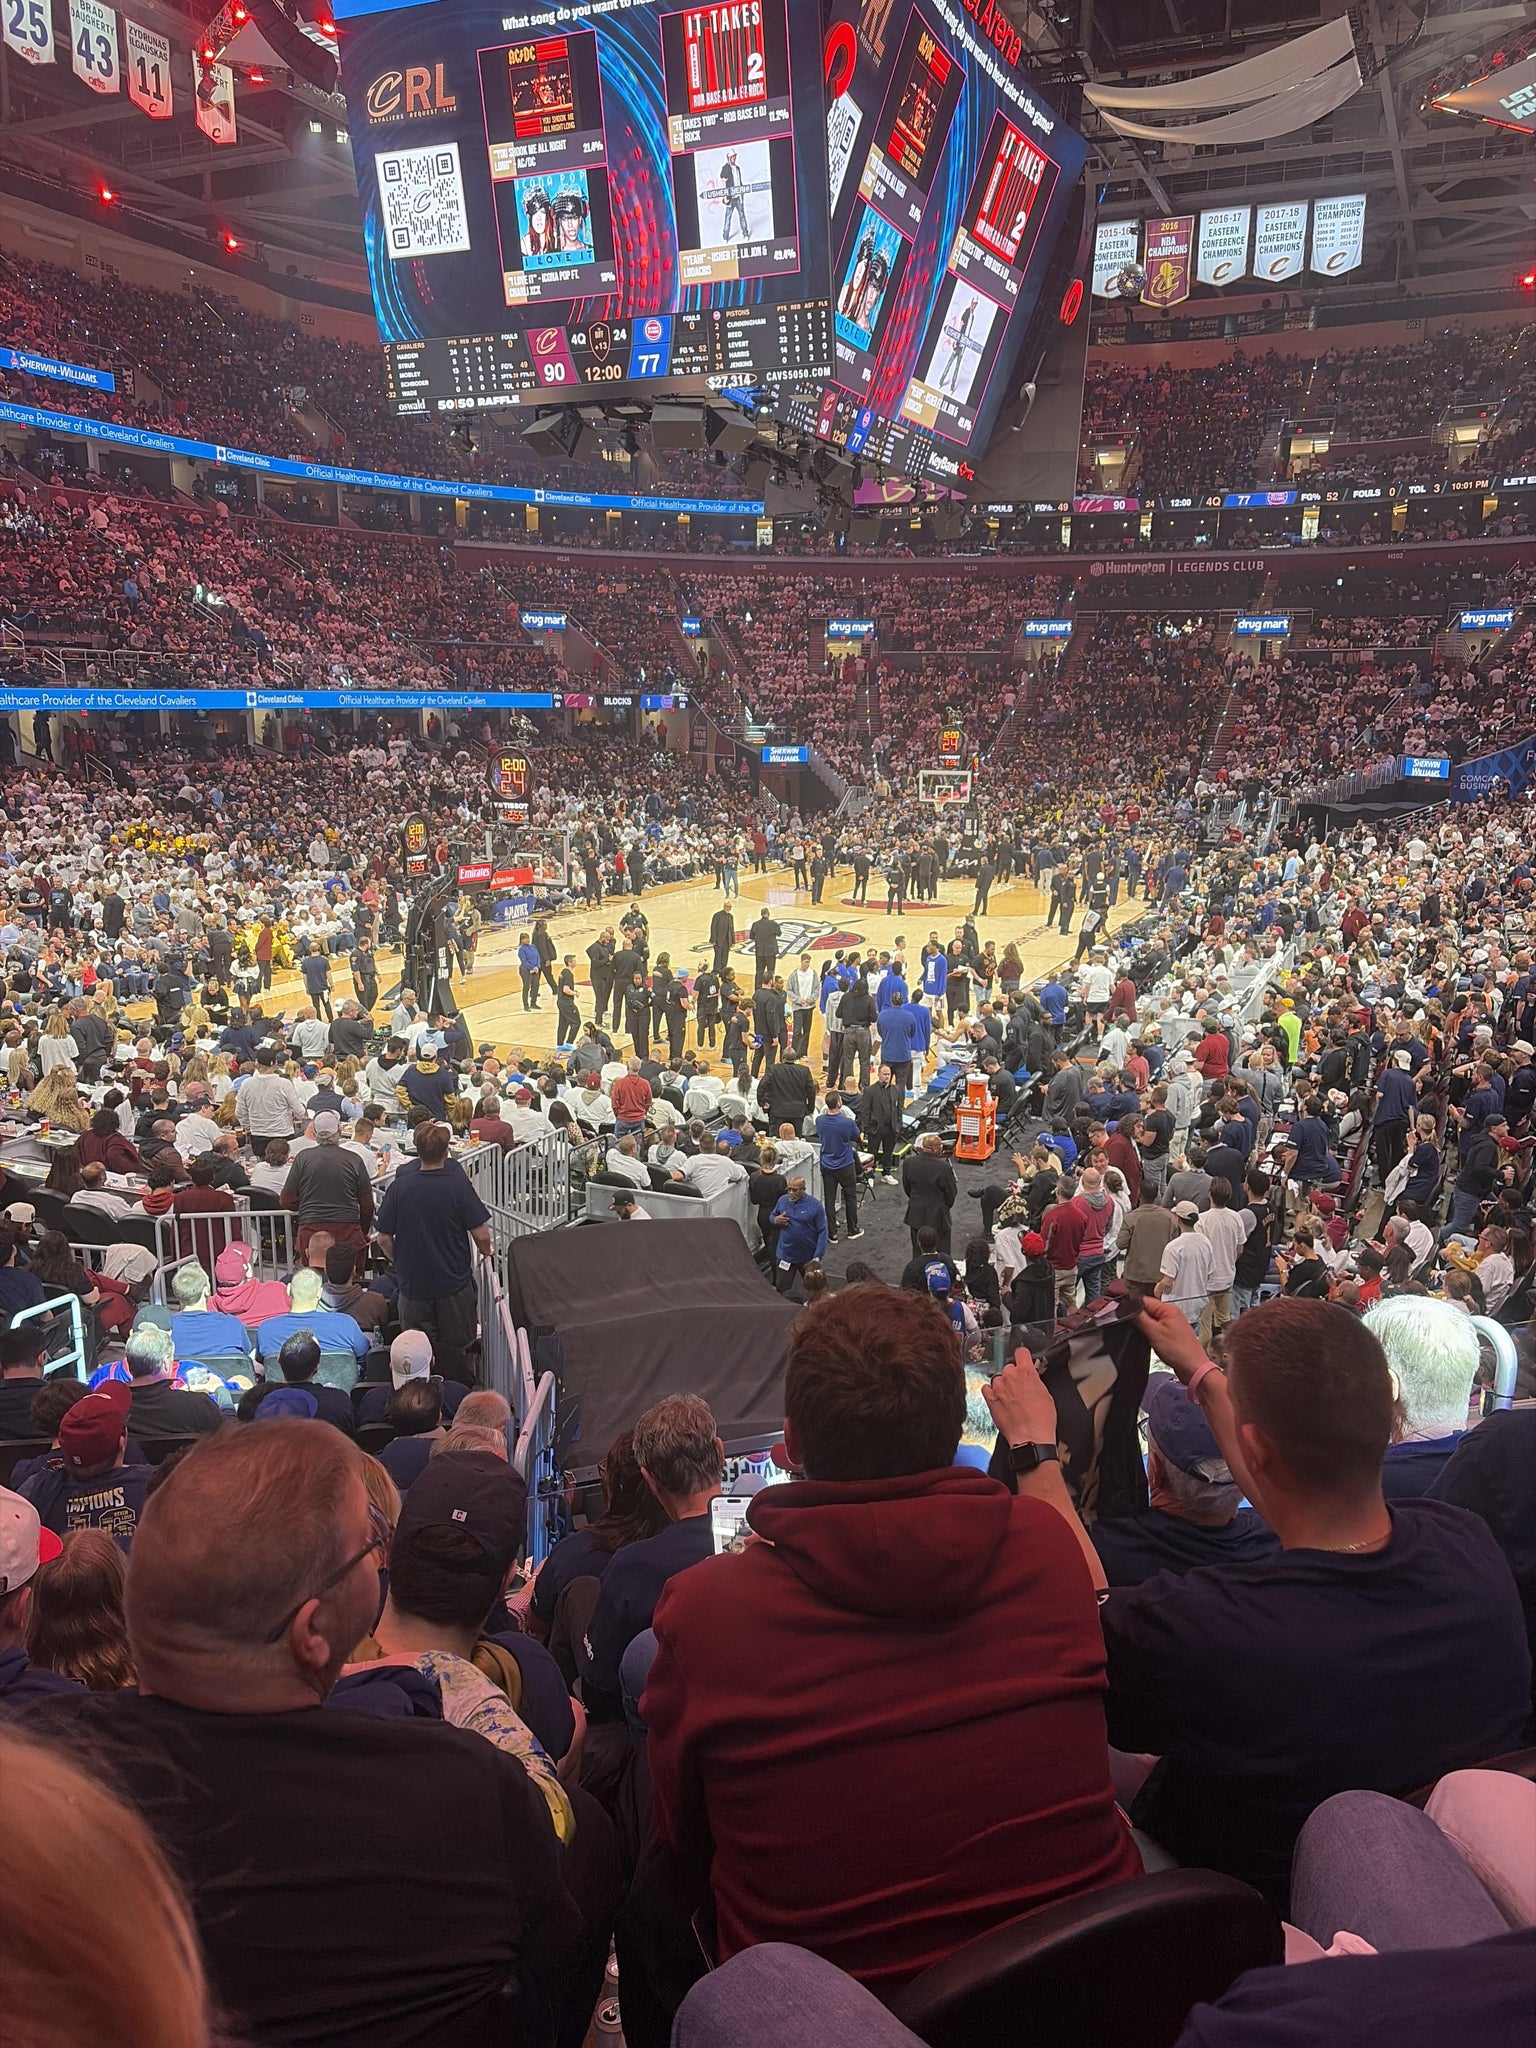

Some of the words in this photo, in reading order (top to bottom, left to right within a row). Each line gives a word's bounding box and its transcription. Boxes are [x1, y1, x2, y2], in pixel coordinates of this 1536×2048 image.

[80, 0, 104, 19] BRAD
[502, 17, 529, 31] What
[530, 10, 556, 25] song
[557, 8, 571, 21] do
[571, 5, 591, 21] you
[592, 0, 619, 13] want
[7, 0, 48, 47] 25
[688, 13, 702, 38] IT
[710, 2, 760, 34] TAKES
[128, 25, 167, 51] ZYDRUNAS
[978, 0, 1022, 67] Arena
[77, 27, 113, 78] 43
[129, 36, 168, 62] ILGAUSKAS
[508, 45, 536, 65] AC/DC
[747, 52, 764, 81] 2
[944, 9, 957, 36] song
[963, 32, 975, 54] you
[974, 43, 989, 65] want
[993, 64, 1006, 87] hear
[1004, 77, 1020, 100] later
[1033, 111, 1055, 136] game?
[137, 56, 164, 102] 11
[706, 90, 722, 106] BASE
[1499, 86, 1535, 109] LET
[369, 114, 404, 125] CAVALIERS
[409, 109, 439, 119] REQUEST
[442, 105, 457, 113] LIVE
[682, 118, 702, 130] TAKES
[736, 108, 754, 121] BASE
[768, 108, 790, 122] 11.2%
[684, 130, 700, 143] ROCK
[517, 156, 536, 168] AC/DC
[1001, 130, 1016, 159] IT
[1014, 141, 1045, 185] TAKES
[1316, 204, 1339, 212] CENTRAL
[1340, 200, 1364, 210] DIVISION
[1208, 212, 1242, 224] 2016-17
[1264, 208, 1300, 220] 2017-18
[1318, 208, 1361, 220] CHAMPIONS
[1011, 211, 1027, 240] 2
[1098, 227, 1130, 238] 2015-16
[1160, 222, 1178, 231] 2016
[1208, 226, 1240, 238] EASTERN
[1265, 220, 1298, 232] EASTERN
[1161, 236, 1176, 246] NBA
[1202, 236, 1245, 248] CONFERENCE
[1258, 230, 1303, 244] CONFERENCE
[1100, 240, 1129, 250] EASTERN
[1148, 244, 1188, 258] CHAMPIONS
[1260, 242, 1300, 255] CHAMPIONS
[538, 252, 572, 264] LOVE
[1094, 250, 1134, 261] CONFERENCE
[1203, 247, 1242, 260] CHAMPIONS
[726, 309, 750, 318] PISTONS
[726, 318, 766, 328] CUNNINGHAM
[570, 333, 586, 345] 4Q
[612, 328, 627, 341] 24
[397, 342, 426, 351] CAVALIERS
[728, 340, 749, 349] LEVERT
[728, 350, 750, 358] HARRIS
[638, 354, 661, 374] 77
[730, 360, 753, 369] JENKINS
[544, 362, 566, 382] 90
[584, 364, 622, 382] 12:00
[766, 366, 831, 382] CAVS5050.COM
[708, 375, 750, 391] $27,314
[398, 398, 426, 411] oswald
[478, 395, 520, 406] RAFFLE
[36, 412, 72, 430] Provider
[74, 420, 82, 432] of
[85, 422, 98, 435] the
[100, 426, 139, 443] Cleveland
[140, 434, 175, 450] Cavaliers
[832, 430, 848, 446] 12:00
[928, 451, 960, 476] KeyBank
[226, 451, 254, 465] Cleveland
[254, 455, 270, 468] Clinic
[306, 466, 334, 480] Official
[335, 470, 373, 484] Healthcare
[374, 474, 402, 488] Provider
[403, 478, 411, 489] of
[412, 479, 423, 490] the
[424, 480, 459, 495] Cleveland
[460, 484, 494, 497] Cavaliers
[1113, 500, 1126, 510] 90
[1170, 498, 1192, 507] 12:00
[1206, 496, 1222, 507] 4Q
[1238, 496, 1250, 506] 77
[1300, 492, 1321, 502] FG%
[1326, 492, 1338, 501] 52
[1352, 488, 1381, 498] FOULS
[1408, 485, 1426, 494] TOL
[1451, 480, 1473, 490] 10:01
[1475, 480, 1489, 489] PM
[1503, 476, 1526, 486] LET
[545, 492, 574, 502] Cleveland
[574, 494, 592, 504] Clinic
[630, 498, 658, 510] Official
[659, 500, 697, 511] Healthcare
[698, 502, 728, 512] Provider
[729, 502, 736, 512] of
[738, 503, 750, 512] the
[1177, 562, 1230, 573] LEGENDS
[1233, 560, 1264, 571] CLUB
[522, 614, 544, 627] drug
[544, 614, 567, 625] mart
[1237, 618, 1262, 632] drug
[1262, 618, 1288, 630] mart
[1461, 612, 1486, 626] drug
[1486, 610, 1513, 624] mart
[829, 622, 850, 634] drug
[852, 622, 874, 632] mart
[1026, 622, 1048, 634] drug
[1049, 622, 1072, 632] mart
[42, 692, 82, 706] Provider
[85, 693, 96, 706] of
[97, 694, 112, 706] the
[114, 694, 157, 706] Cleveland
[159, 694, 196, 706] Cavaliers
[258, 694, 288, 704] Cleveland
[288, 694, 304, 704] Clinic
[338, 695, 363, 705] Official
[363, 696, 395, 705] Healthcare
[396, 696, 419, 705] Provider
[437, 696, 463, 706] Cleveland
[463, 696, 486, 706] Cavaliers
[604, 697, 632, 706] BLOCKS
[770, 746, 800, 755] SHERWIN
[942, 738, 958, 752] 24
[501, 758, 526, 772] 12:00
[1412, 758, 1441, 768] SHERWIN
[500, 770, 525, 796] 24
[502, 802, 529, 810] TISSOT
[506, 810, 524, 821] 2:55
[407, 824, 424, 835] 12:00
[408, 836, 422, 850] 24
[410, 861, 425, 872] 2:55
[460, 867, 490, 880] Emirates
[456, 1512, 464, 1520] C
